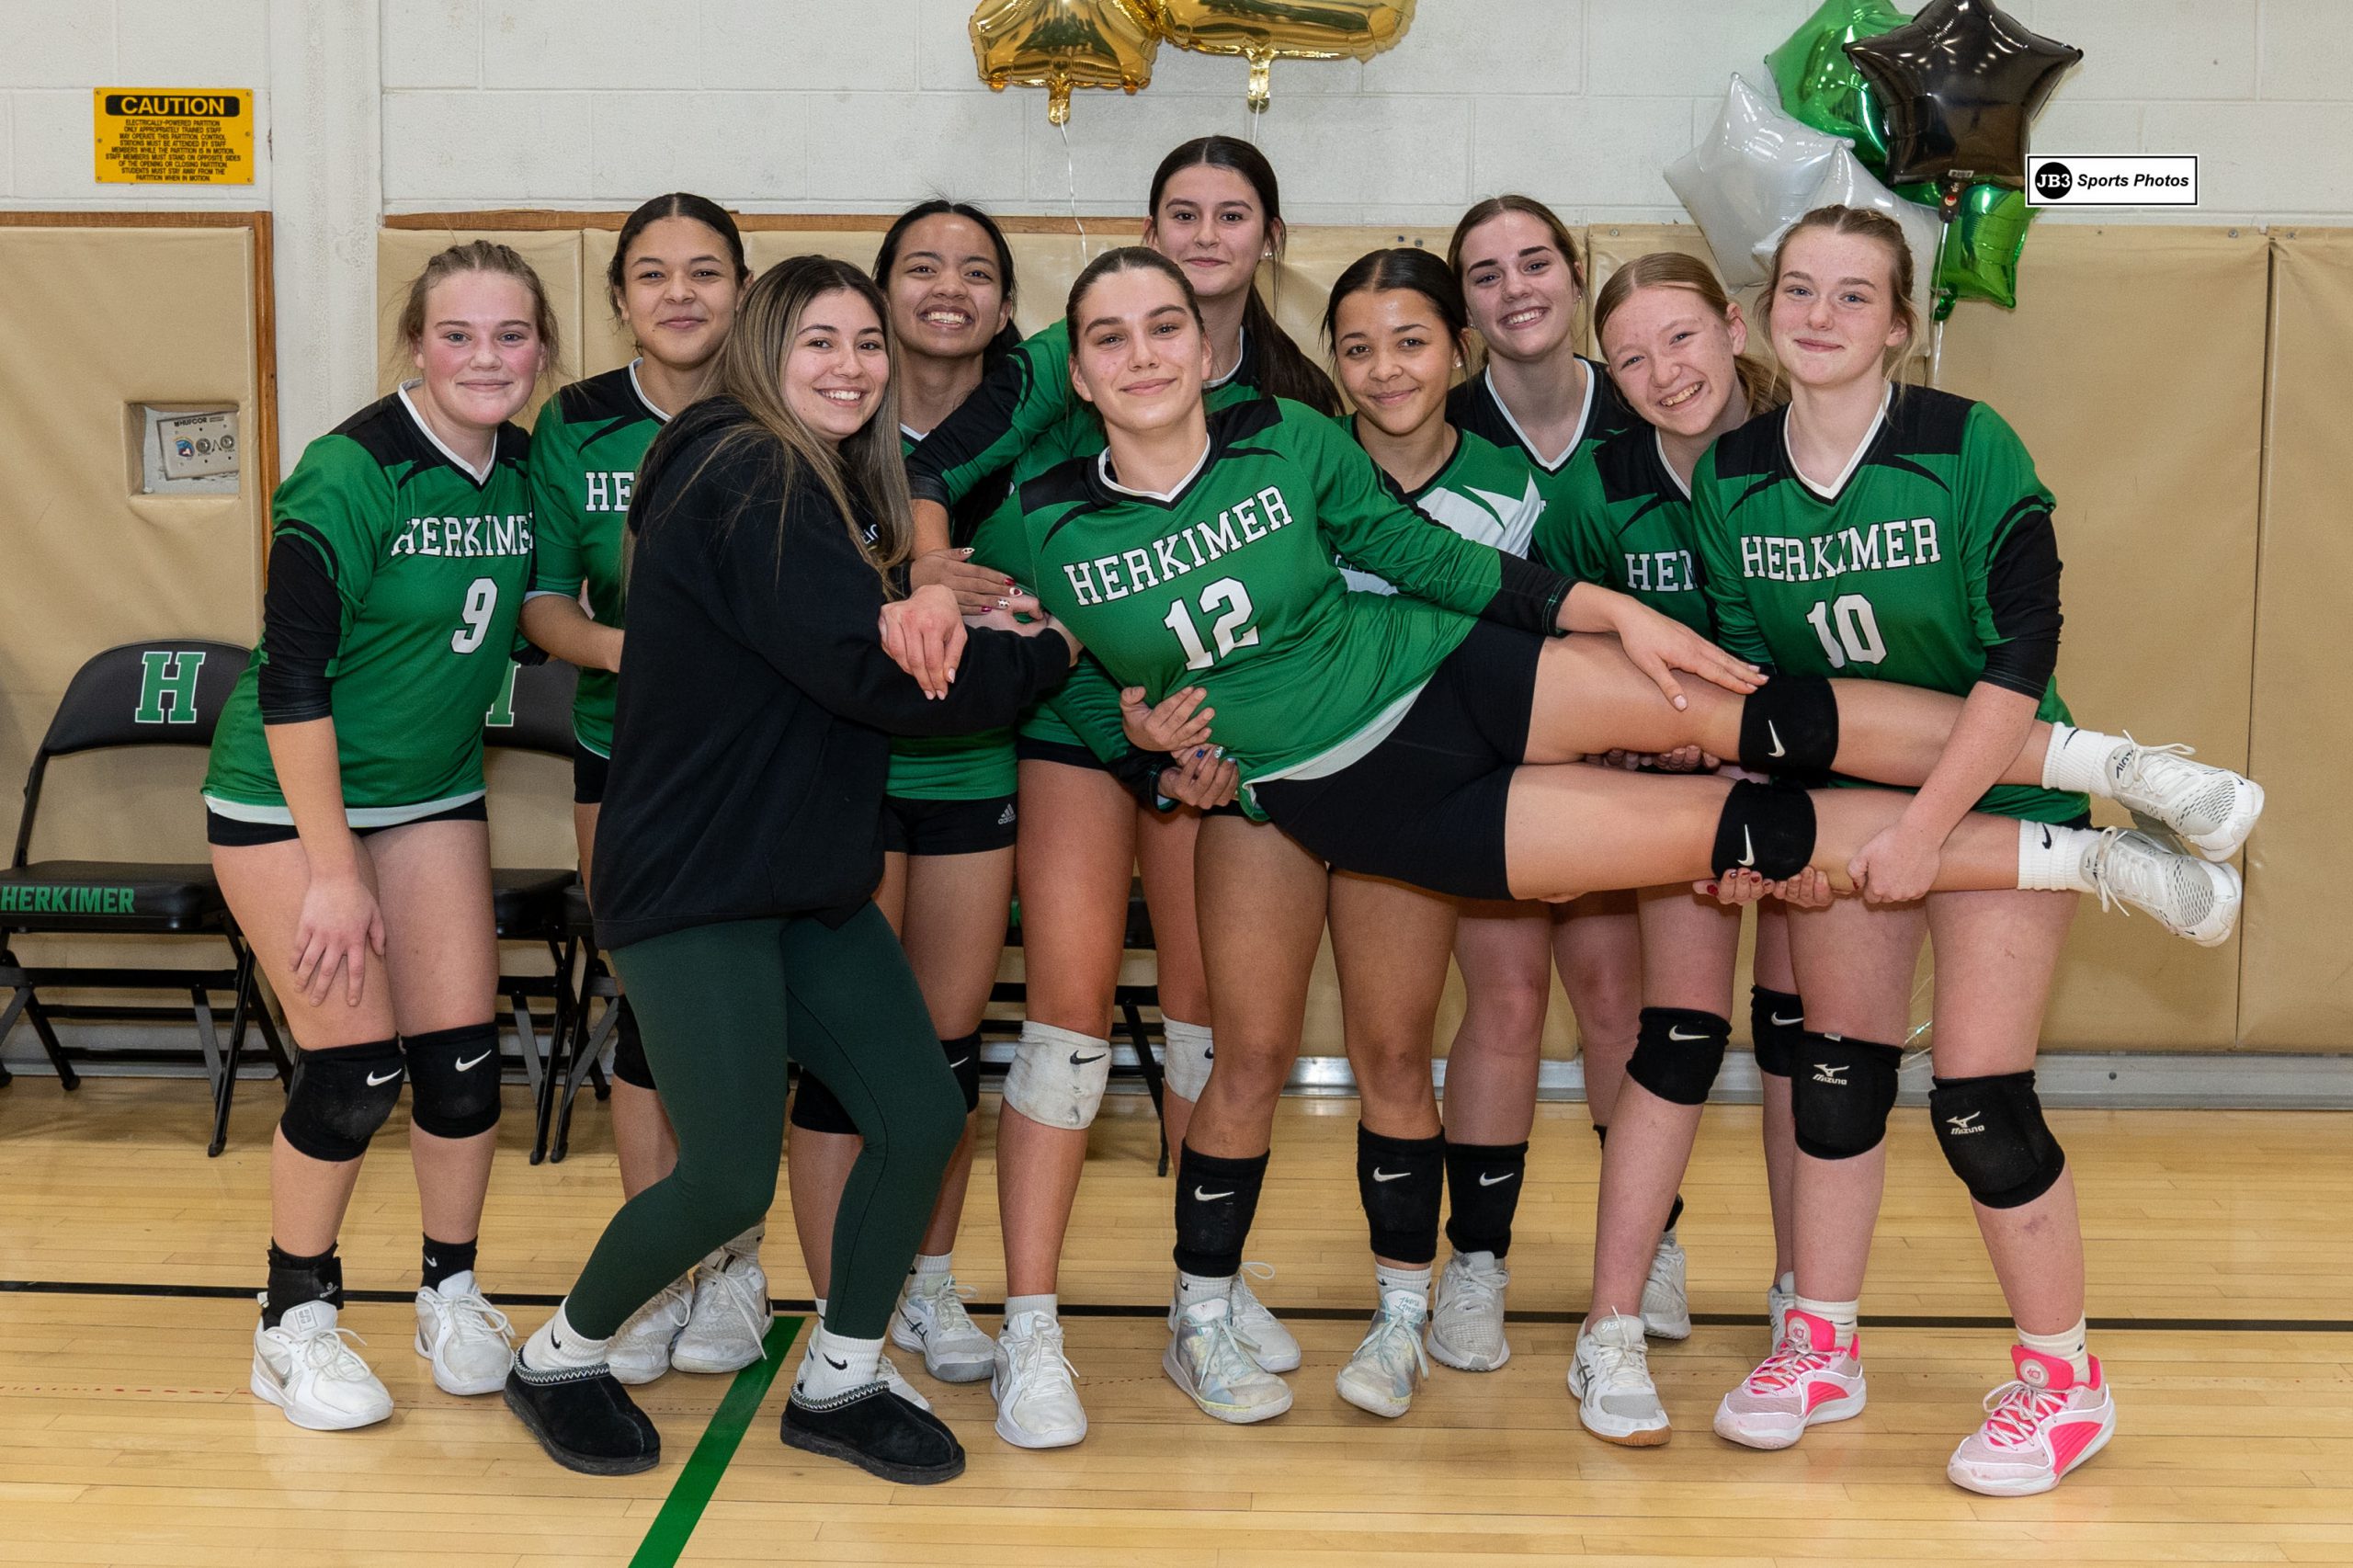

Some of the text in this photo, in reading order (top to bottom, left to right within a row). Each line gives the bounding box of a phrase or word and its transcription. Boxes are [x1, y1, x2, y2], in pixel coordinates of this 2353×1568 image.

[120, 97, 225, 115] CAUTION
[391, 511, 533, 558] HERKIME
[1062, 484, 1294, 607] HERKIMER
[1740, 517, 1941, 583] HERKIMER
[450, 577, 498, 654] 9
[1162, 575, 1260, 671] 12
[1804, 593, 1887, 669] 10
[134, 651, 206, 723] H
[0, 885, 135, 914] HERKIMER
